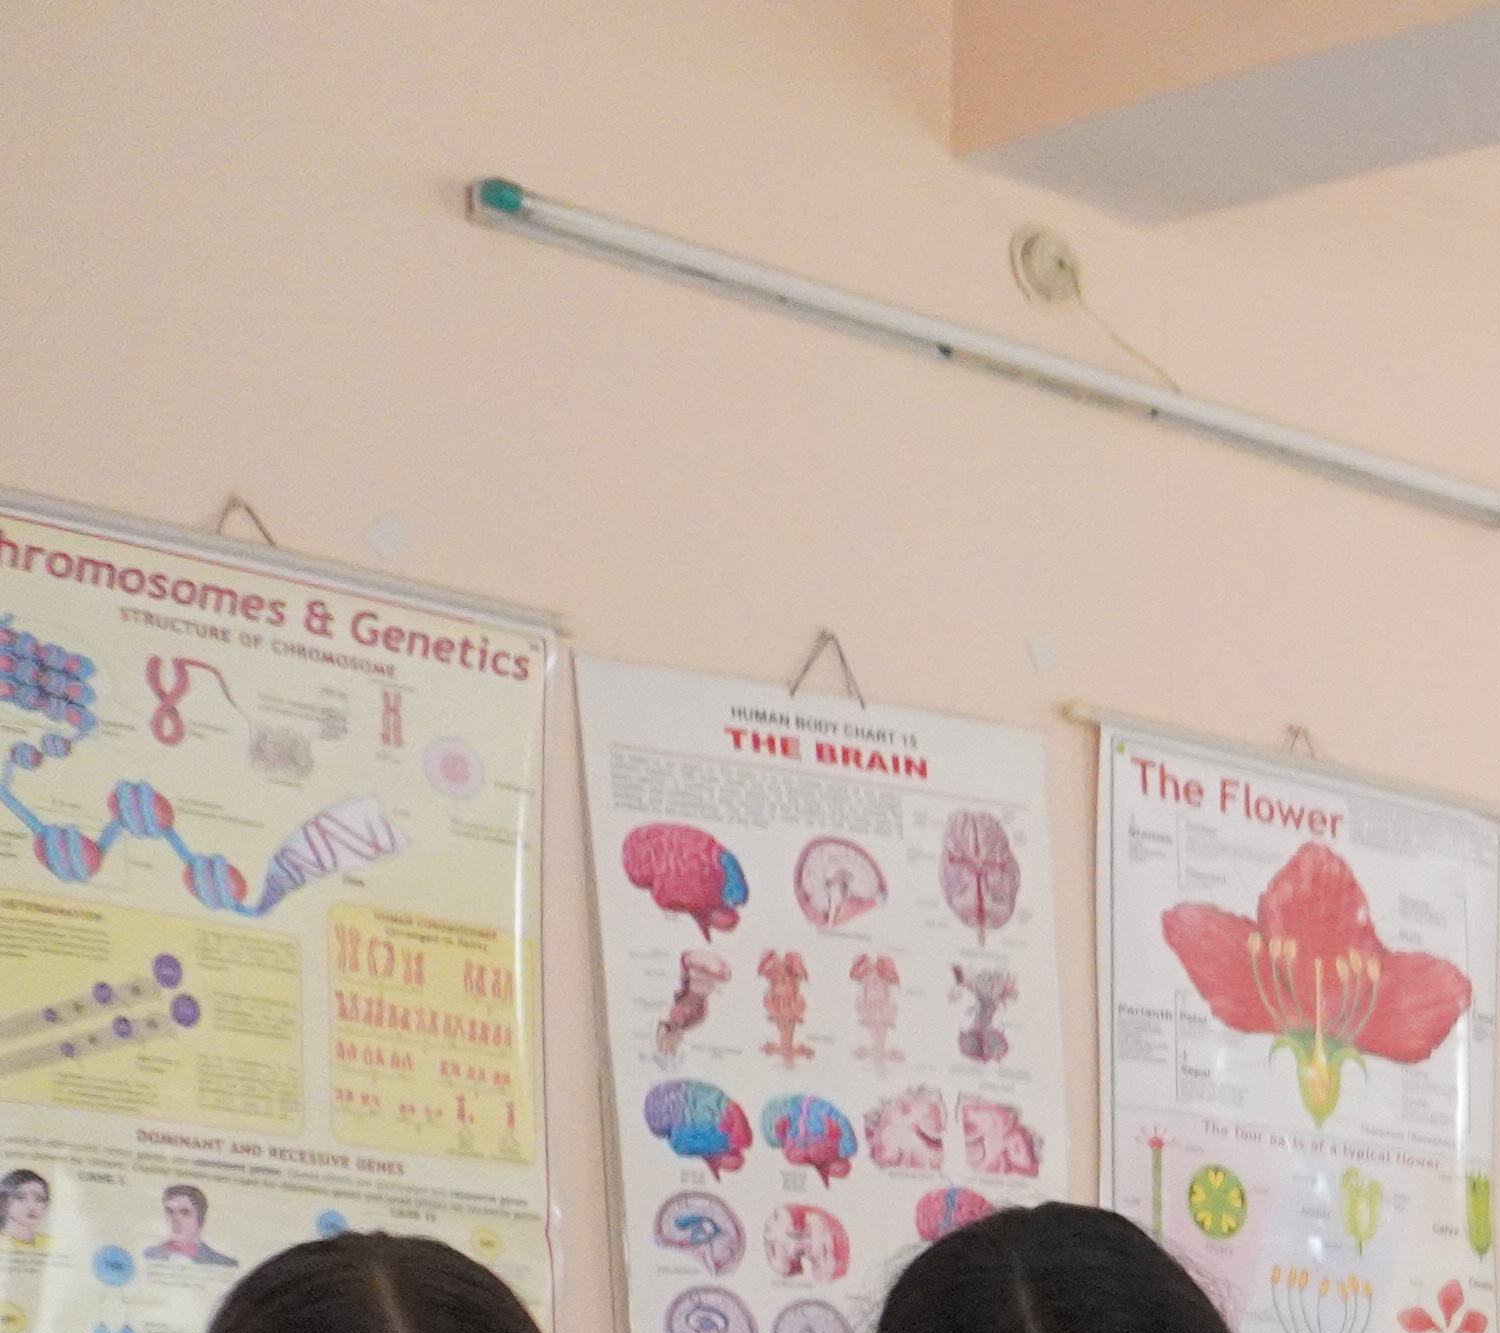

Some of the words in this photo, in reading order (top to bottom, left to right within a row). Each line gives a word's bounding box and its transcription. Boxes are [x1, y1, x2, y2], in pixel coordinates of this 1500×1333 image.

[118, 604, 231, 643] STRUCTURE
[239, 631, 262, 649] OF
[271, 638, 397, 678] CHROMOSOME
[304, 600, 334, 639] &
[351, 610, 530, 681] Genetics
[724, 726, 801, 760] THE
[815, 740, 928, 779] BRAIN
[731, 705, 790, 729] HUMAN
[795, 714, 839, 734] BODY
[843, 724, 896, 744] CHART
[1131, 757, 1204, 807] The
[1219, 777, 1343, 838] Flower
[1203, 1121, 1228, 1137] The
[1234, 1126, 1263, 1142] four
[1269, 1132, 1306, 1150] pats
[1396, 1151, 1440, 1170] flower
